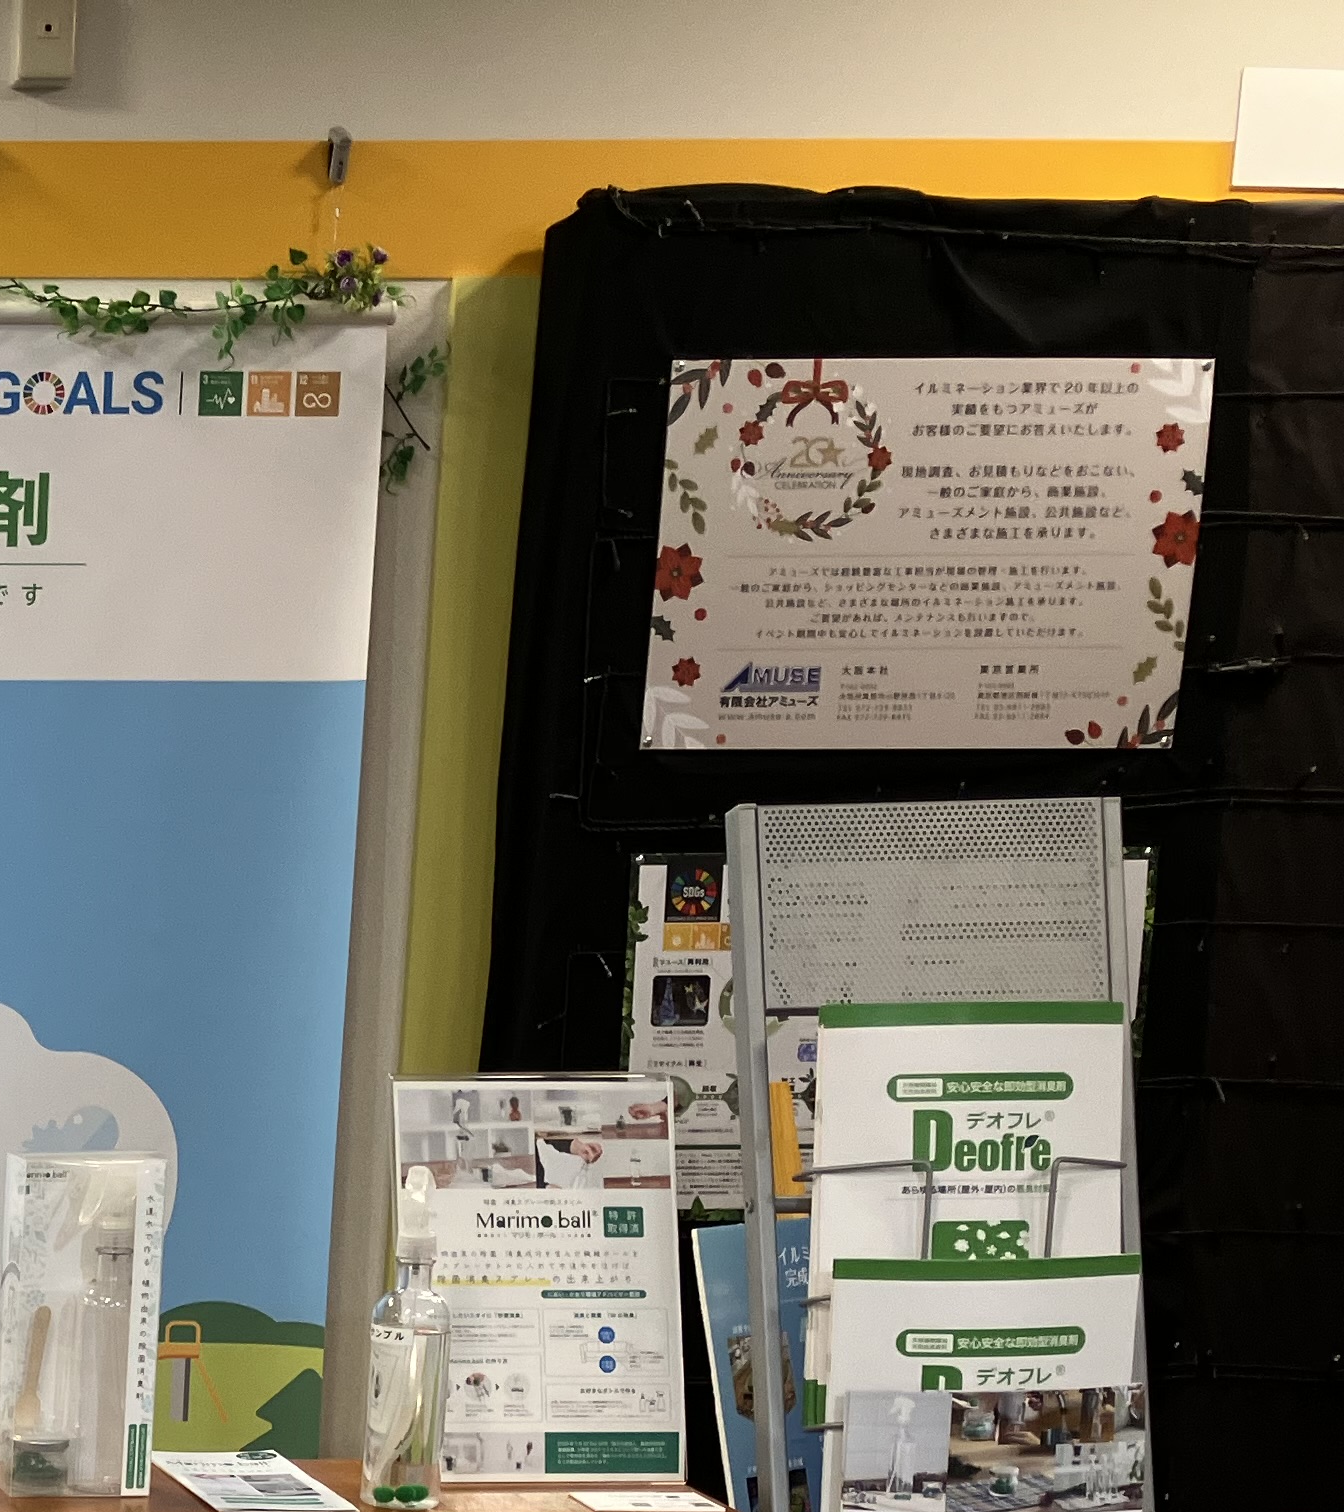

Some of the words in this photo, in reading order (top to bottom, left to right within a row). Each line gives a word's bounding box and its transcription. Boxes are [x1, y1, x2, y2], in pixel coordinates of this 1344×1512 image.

[720, 661, 822, 693] AMUSE
[719, 695, 820, 709] 有限会社アミューズ
[966, 1110, 1042, 1130] デオフレ
[912, 1109, 1052, 1172] Deofre
[976, 1367, 1052, 1386] デオフレ
